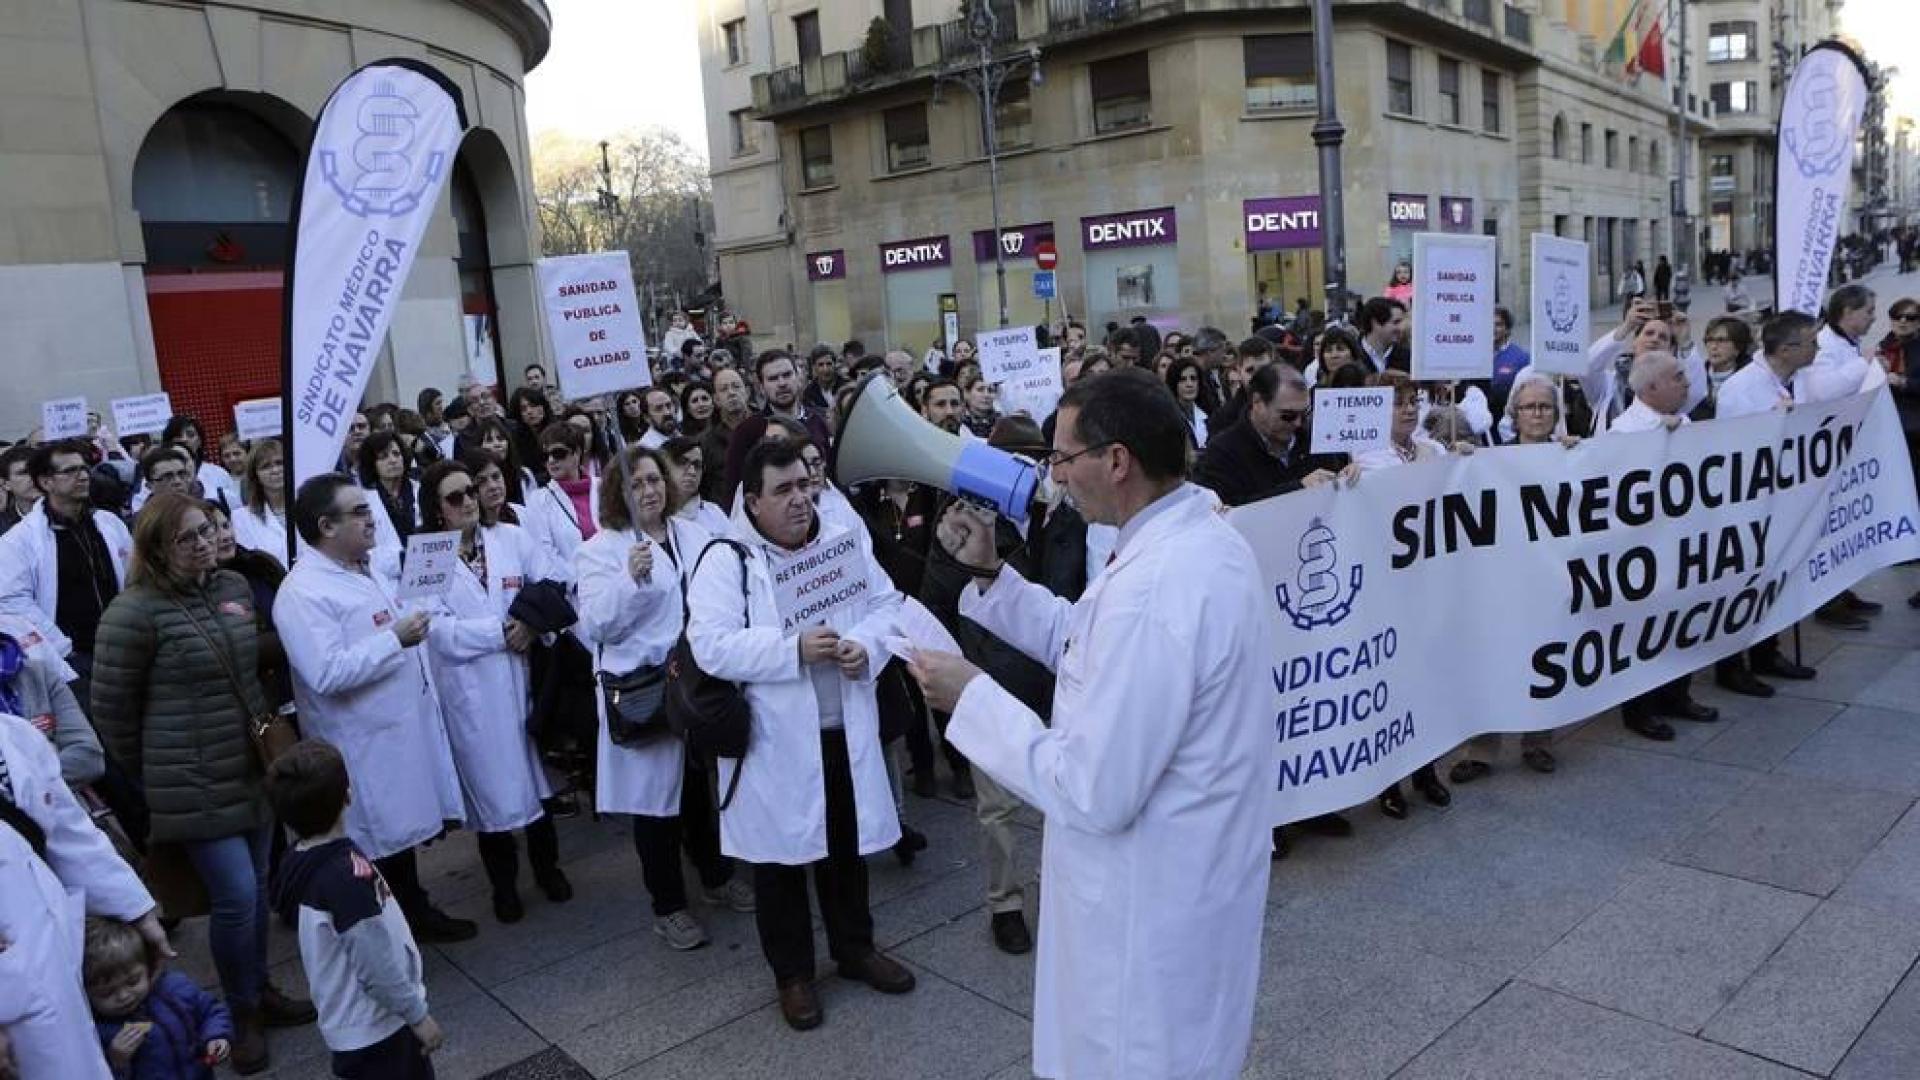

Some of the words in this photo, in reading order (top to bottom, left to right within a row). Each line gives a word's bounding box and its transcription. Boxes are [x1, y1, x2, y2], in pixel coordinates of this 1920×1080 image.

[1391, 201, 1425, 220] DENTIX
[1089, 217, 1165, 243] DENTIX
[1248, 210, 1319, 232] DENTI
[885, 243, 944, 265] DENTIX
[1436, 271, 1477, 282] SANIDAD
[558, 280, 618, 297] SANIDAD
[316, 388, 347, 438] DE
[334, 237, 407, 387] NAVARRA
[589, 329, 606, 341] DE
[1434, 334, 1475, 344] CALIDAD
[297, 314, 346, 424] SINDICATO
[573, 351, 631, 368] CALIDAD
[1001, 359, 1032, 372] SALUD
[1337, 395, 1383, 408] TIEMPO
[1339, 428, 1378, 441] SALUD
[1391, 488, 1497, 571] SIN
[1519, 415, 1863, 542] NEGOCIACIÓN
[422, 540, 453, 553] TIEMPO
[1808, 552, 1829, 582] DE
[1829, 515, 1916, 568] NAVARRA
[1567, 546, 1658, 615] NO
[1676, 514, 1772, 590] HAY
[417, 573, 447, 587] SALUD
[796, 566, 843, 599] ACORDE
[784, 617, 794, 630] A
[1529, 570, 1788, 700] SOLUCIÓN
[1272, 627, 1397, 695] NDICATO
[1277, 709, 1416, 792] NAVARRA
